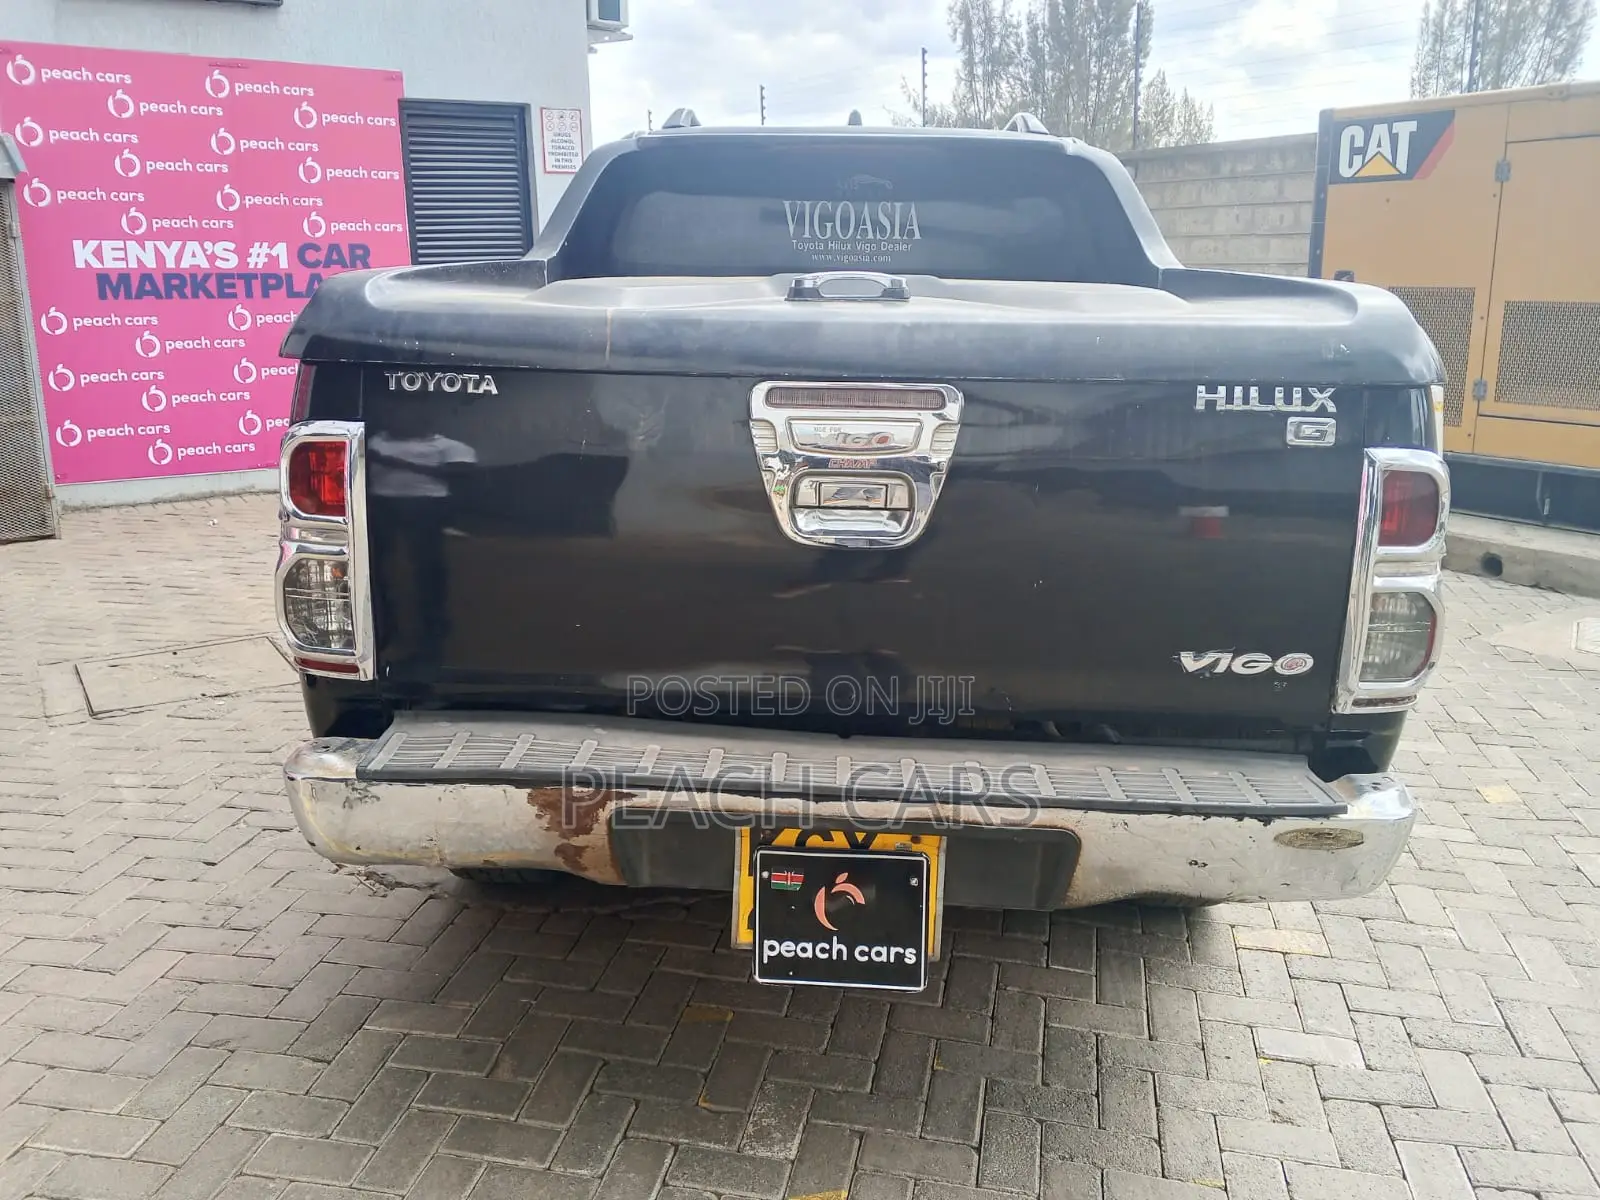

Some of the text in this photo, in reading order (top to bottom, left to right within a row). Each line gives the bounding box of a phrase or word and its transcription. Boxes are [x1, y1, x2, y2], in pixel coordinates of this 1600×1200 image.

[41, 67, 132, 84] peach cars
[235, 81, 314, 97] peach cars
[139, 100, 223, 116] peach cars
[322, 112, 396, 127] peach cars
[49, 128, 139, 144] peach cars
[239, 137, 319, 152] peach cars
[1339, 120, 1418, 178] CAT
[146, 158, 229, 174] peach cars
[326, 166, 400, 180] peach cars
[56, 187, 145, 204] peach cars
[245, 193, 323, 208] peach cars
[152, 215, 234, 231] peach cars
[330, 219, 403, 235] peach cars
[782, 200, 922, 240] VIGOASIA
[72, 239, 371, 269] KENYA'S #1 CAR
[792, 239, 912, 253] Toyota Hilux Vigo Dealer
[812, 253, 891, 263] www.vigoasia.com
[95, 273, 323, 300] MARKETPLA
[72, 313, 159, 331] peach cars
[165, 336, 246, 353] peach cars
[80, 369, 165, 387] peach cars
[384, 371, 499, 395] TOYOTA
[171, 389, 251, 407] peach cars
[1195, 385, 1337, 413] HILUX
[87, 423, 171, 442] peach cars
[266, 418, 290, 432] pea
[177, 442, 256, 460] peach cars
[1179, 650, 1314, 675] VIGO
[763, 936, 917, 964] peach cars
